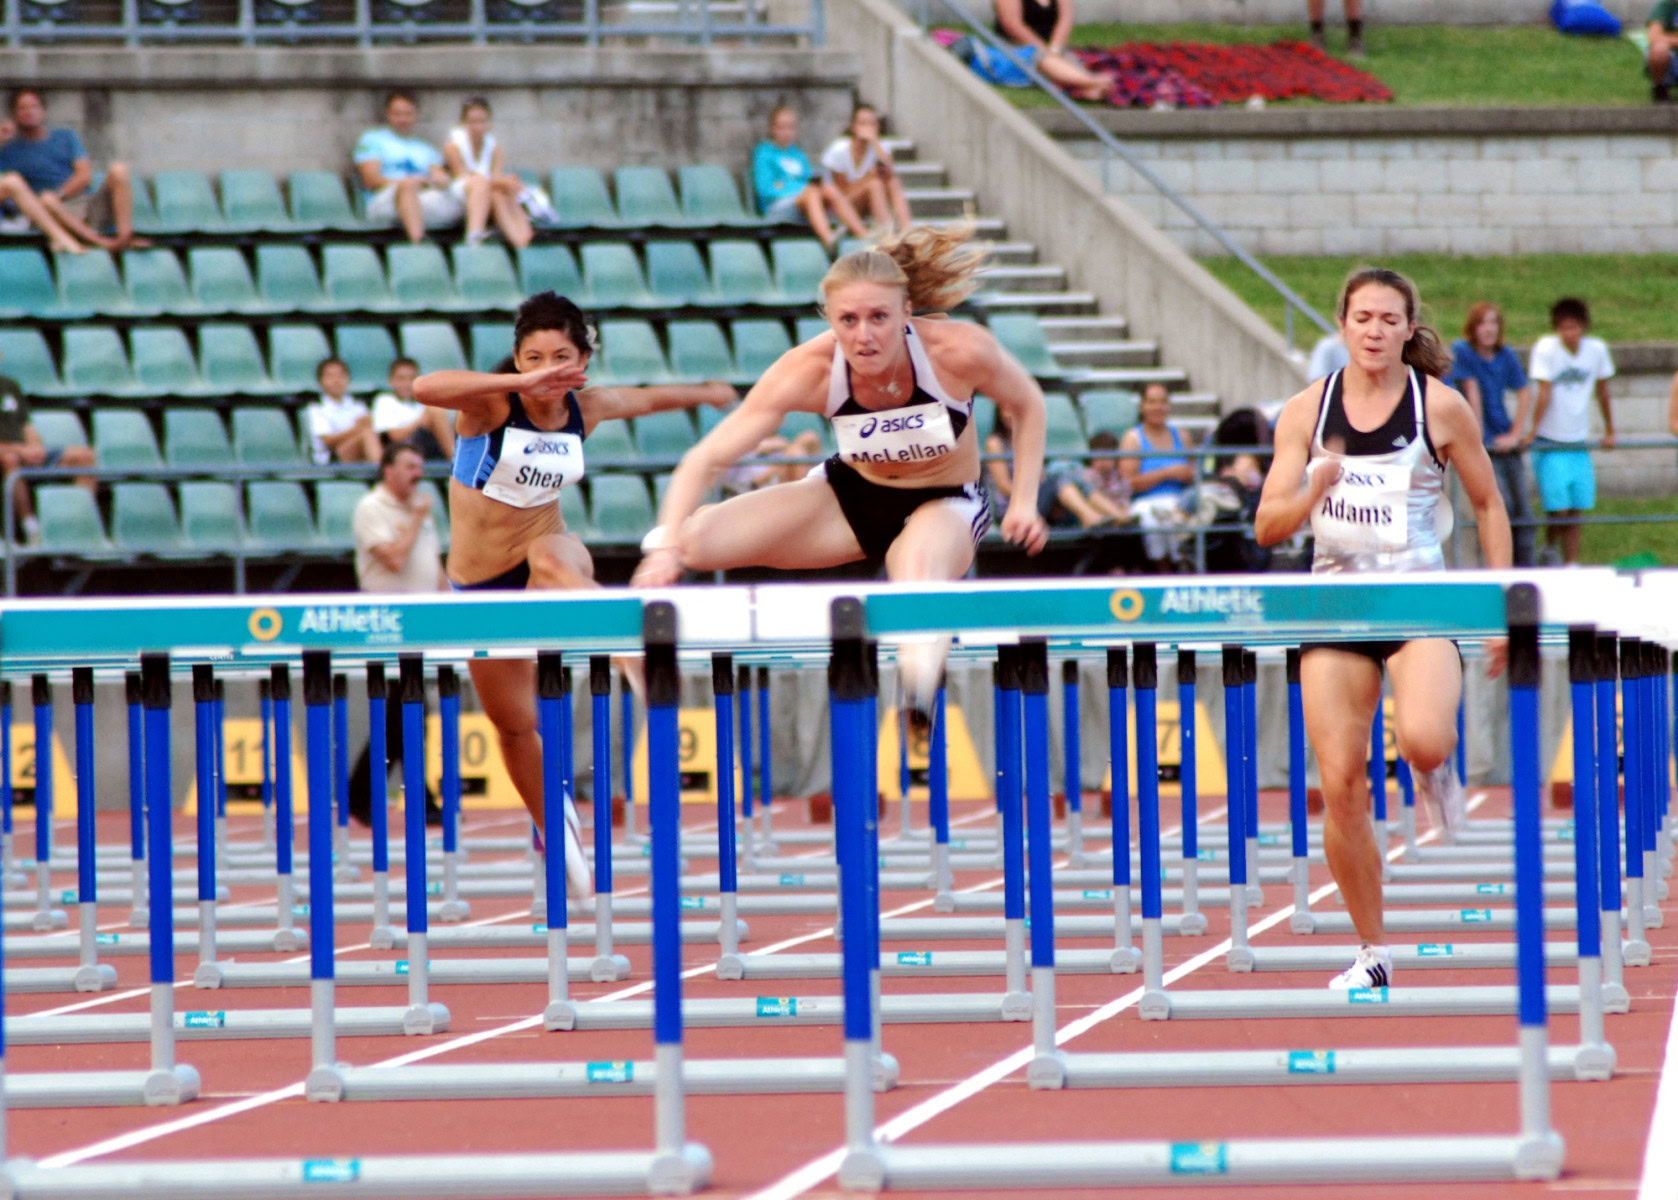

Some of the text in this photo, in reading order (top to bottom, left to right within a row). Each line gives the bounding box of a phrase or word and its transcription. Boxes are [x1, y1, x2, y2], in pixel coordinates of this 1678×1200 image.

[880, 413, 925, 433] asics
[850, 443, 950, 463] McLellan
[515, 465, 564, 489] Shea
[1321, 496, 1393, 526] Adams
[1159, 587, 1264, 614] Athletic
[298, 606, 404, 633] Athletic
[679, 727, 699, 762] 9
[1156, 720, 1181, 755] 7
